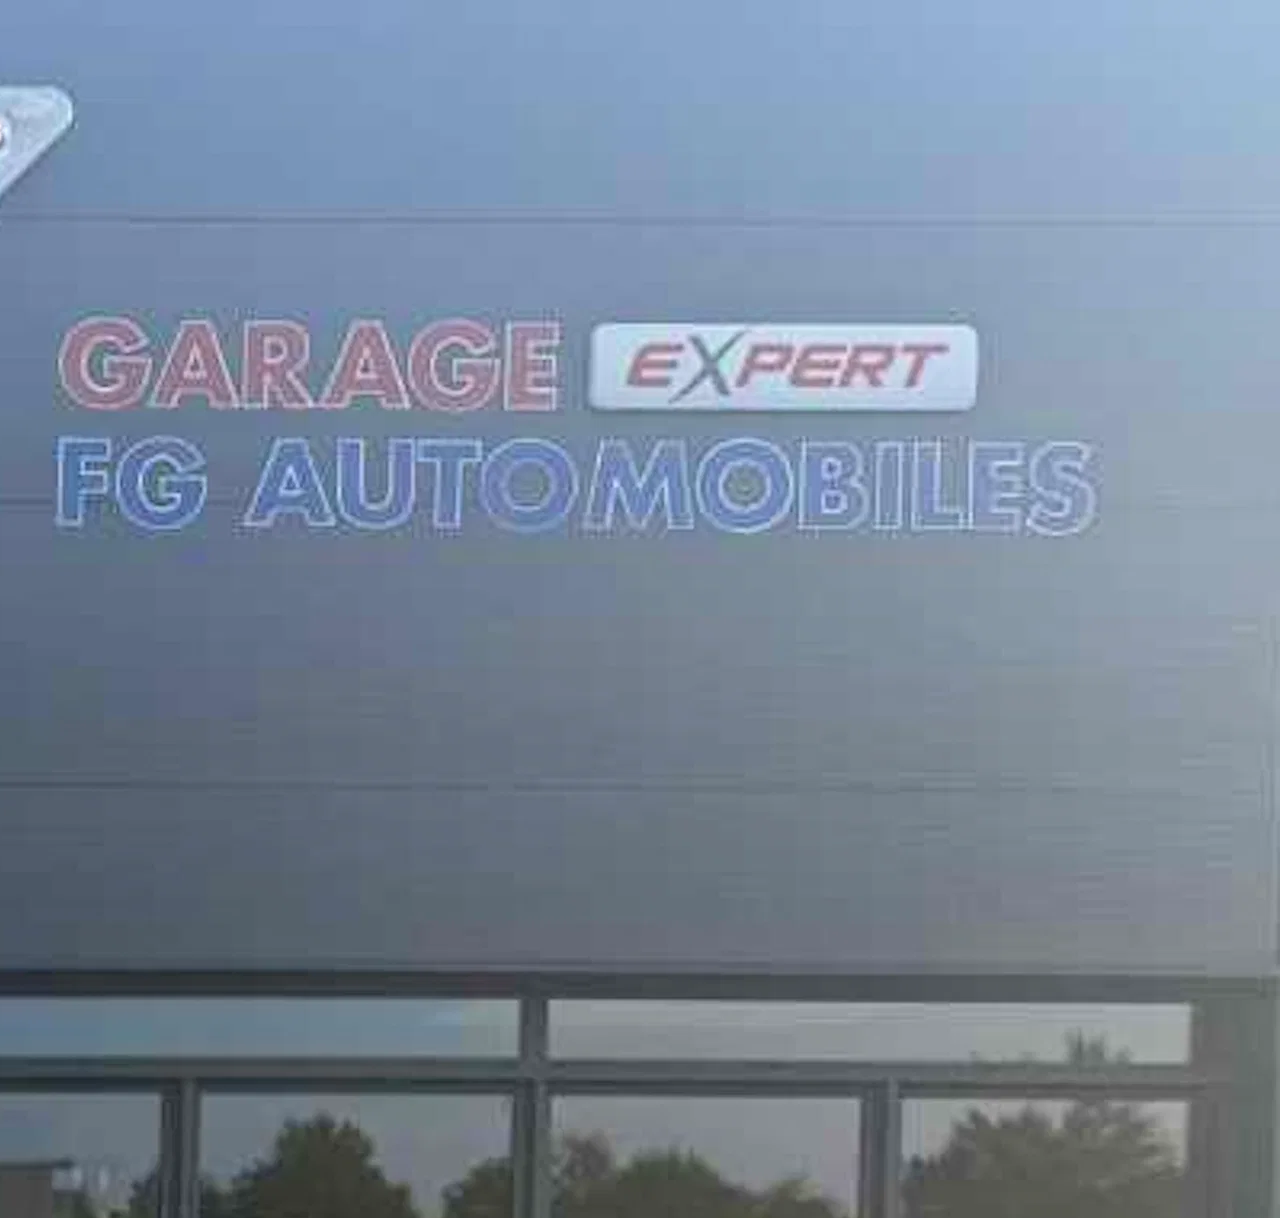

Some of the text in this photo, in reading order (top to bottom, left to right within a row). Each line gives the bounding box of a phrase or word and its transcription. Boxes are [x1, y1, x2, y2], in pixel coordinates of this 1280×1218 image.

[58, 316, 949, 410] GARAGE EXPERT
[53, 436, 1098, 535] FG AUTOMOBILES
